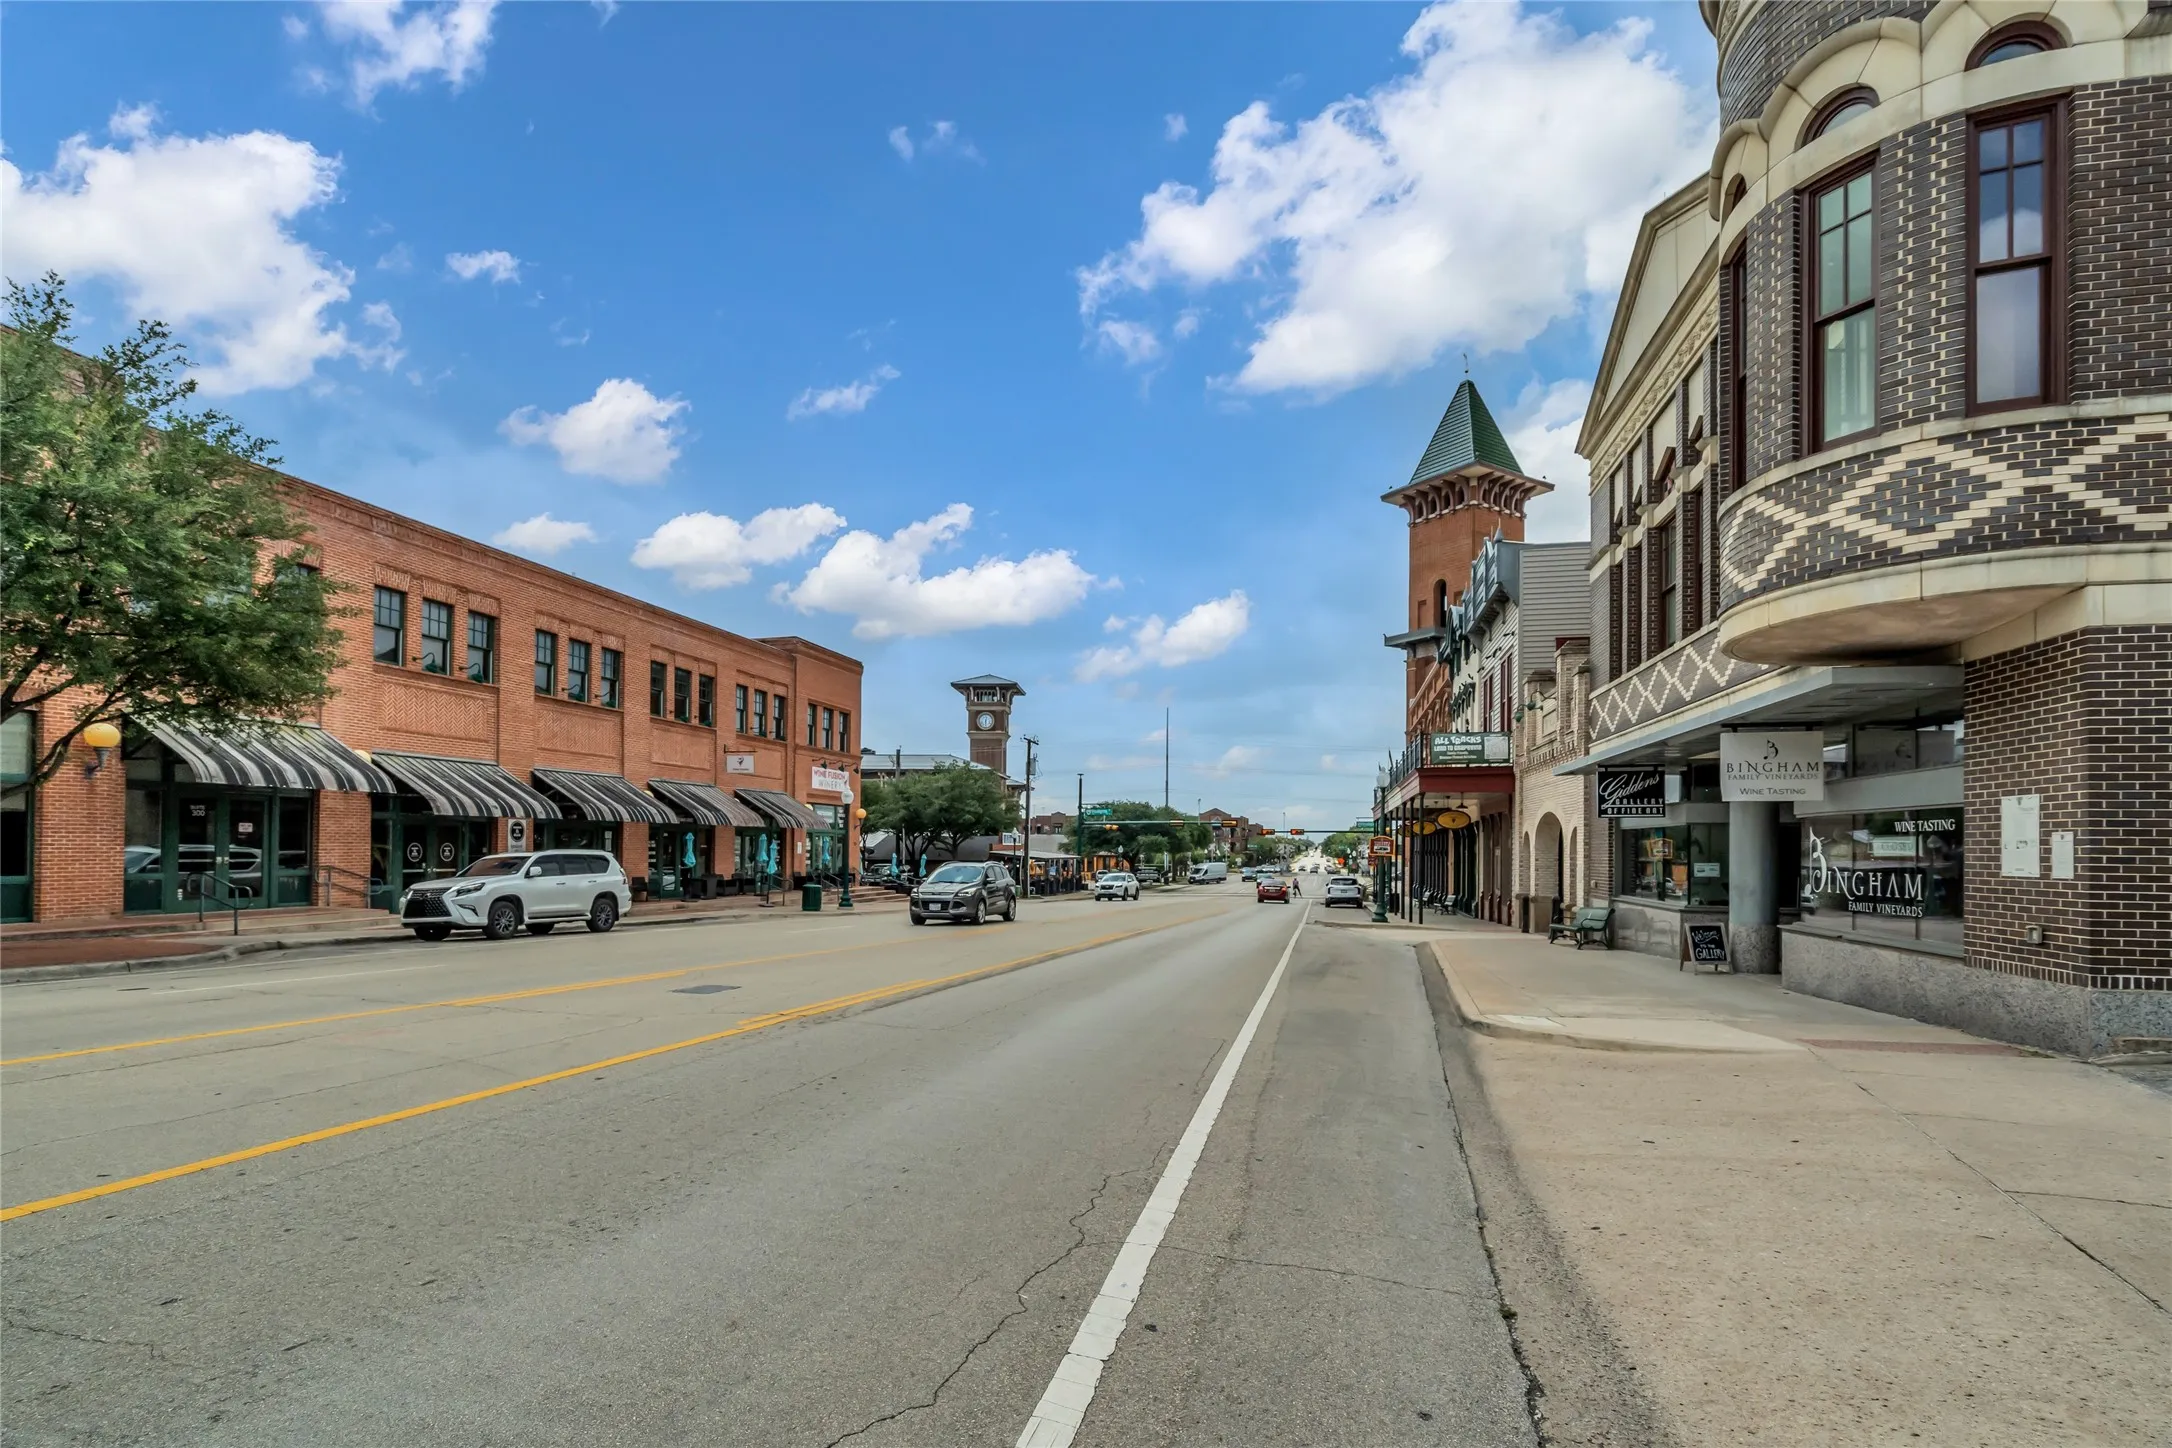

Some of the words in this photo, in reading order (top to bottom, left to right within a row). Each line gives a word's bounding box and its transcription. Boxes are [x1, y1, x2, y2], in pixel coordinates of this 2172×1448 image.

[1434, 737, 1449, 745] ALL
[1450, 736, 1482, 744] TRACKS
[1726, 760, 1820, 774] BINGHAM
[814, 769, 827, 778] WINE
[828, 771, 846, 780] FUSION
[1599, 772, 1660, 809] Giddens
[1766, 787, 1806, 795] TASTING
[1894, 820, 1916, 832] WINE
[1917, 819, 1956, 832] TASTING
[1804, 826, 1923, 900] BINGHAM
[1848, 901, 1874, 913] FAMILY
[1876, 903, 1923, 918] VINEYARDS
[1695, 948, 1725, 960] GALLERY
